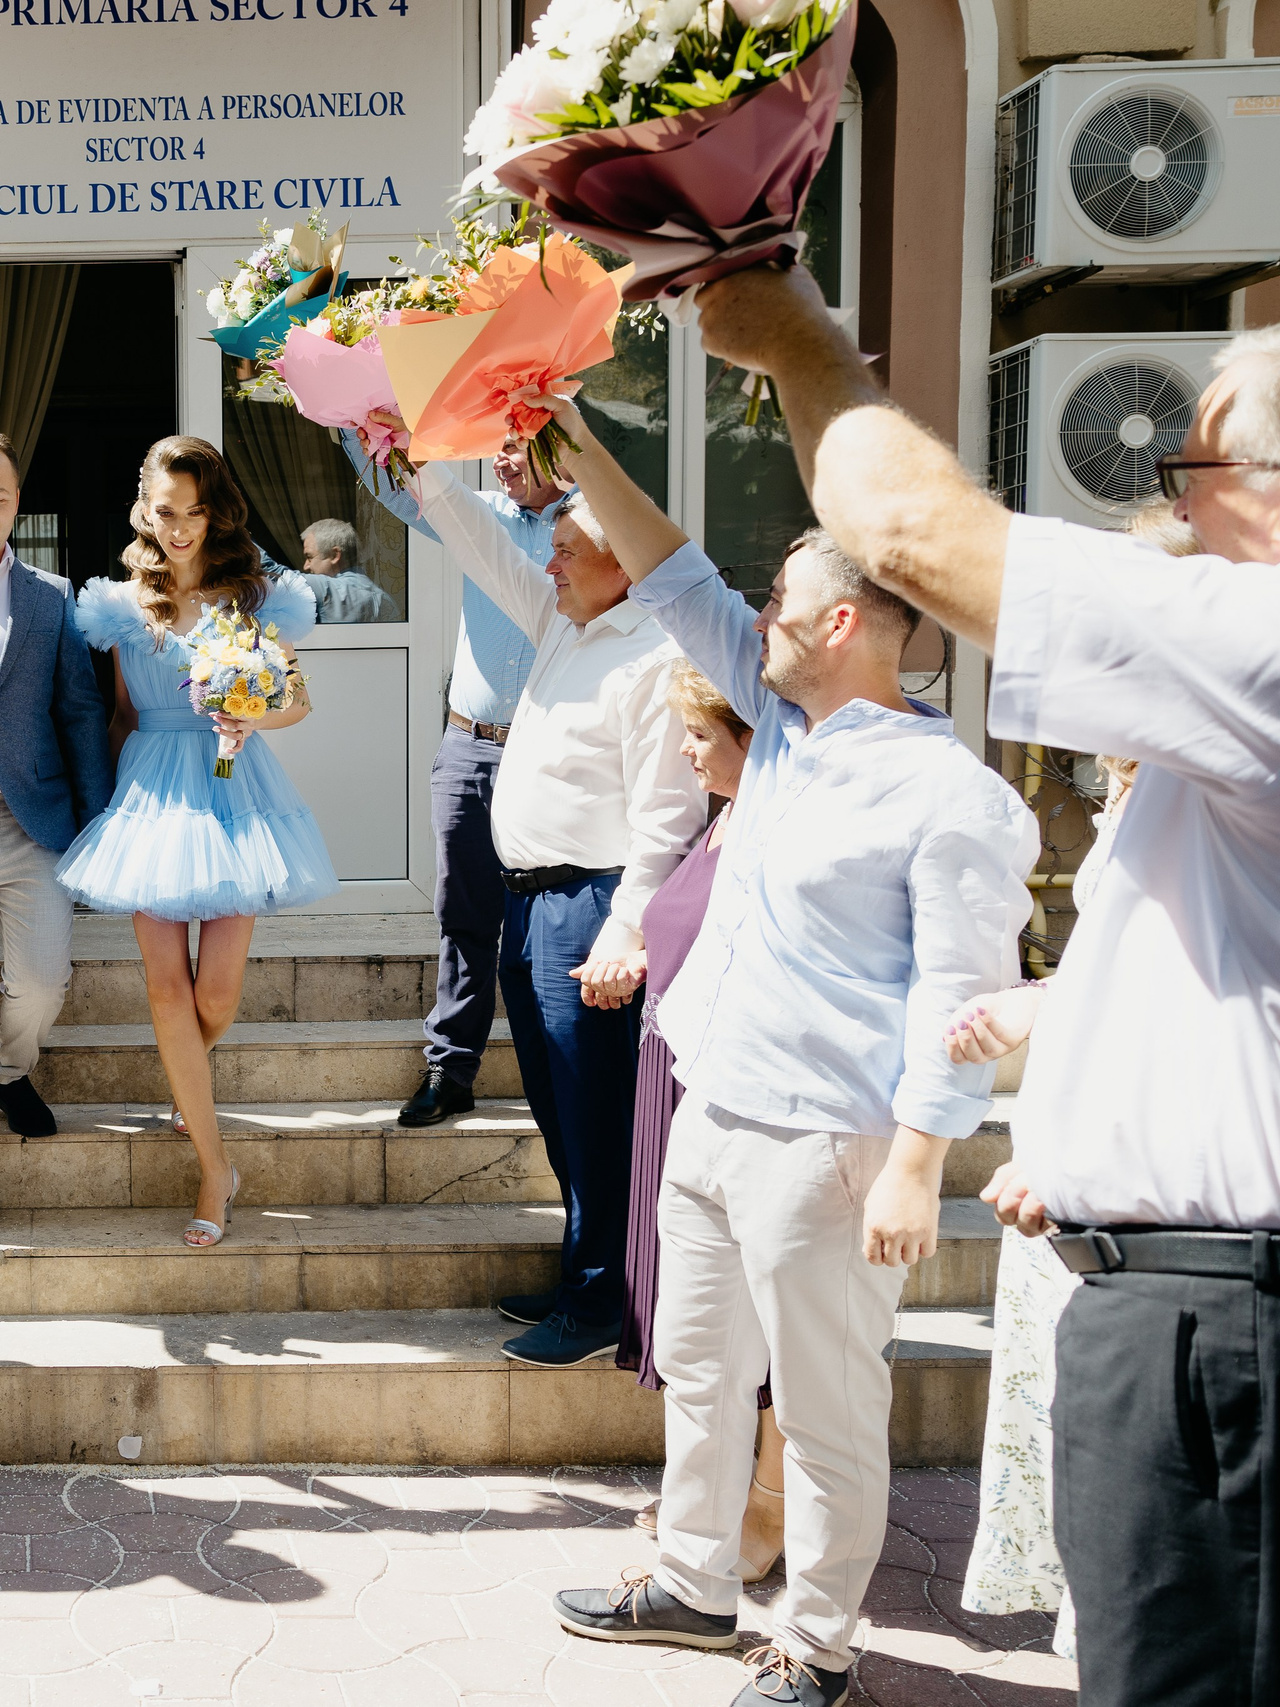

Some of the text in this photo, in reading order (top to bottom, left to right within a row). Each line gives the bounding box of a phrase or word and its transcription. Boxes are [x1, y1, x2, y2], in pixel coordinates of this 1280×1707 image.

[210, 0, 378, 22] SECTOR
[388, 0, 409, 17] 4
[16, 99, 52, 125] DE
[57, 95, 191, 124] EVIDENTA
[196, 95, 216, 121] A
[221, 91, 406, 120] PERSOANELOR
[85, 136, 206, 163] SECTOR 4
[88, 182, 141, 213] DE
[150, 179, 265, 212] STARE
[273, 175, 402, 209] CIVILA
